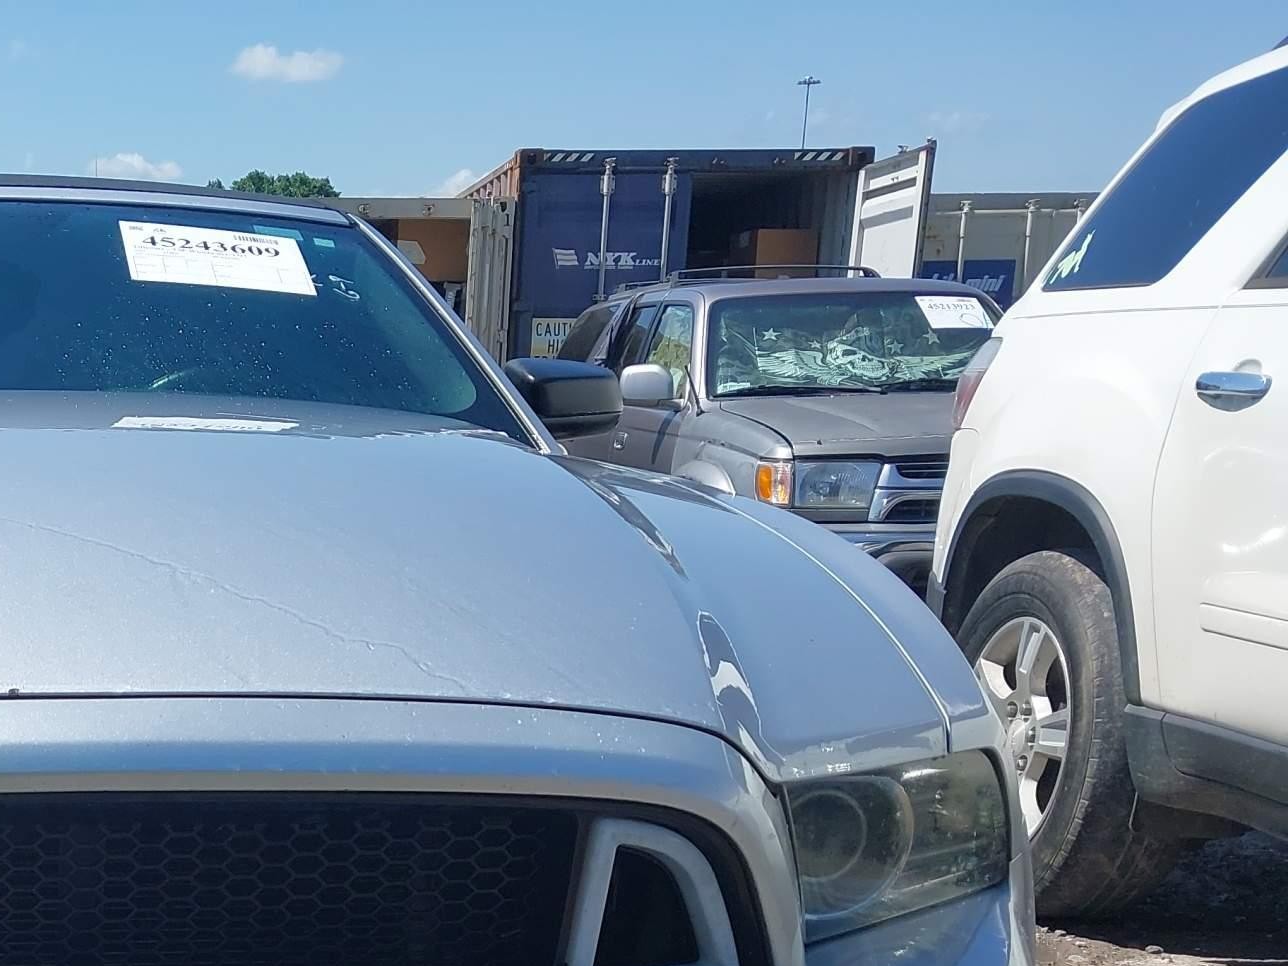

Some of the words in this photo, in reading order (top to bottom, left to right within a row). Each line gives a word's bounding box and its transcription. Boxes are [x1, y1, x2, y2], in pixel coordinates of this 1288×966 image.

[142, 235, 281, 258] 45243609
[585, 252, 637, 266] NYK
[636, 258, 662, 266] LINE
[547, 338, 564, 354] HI
